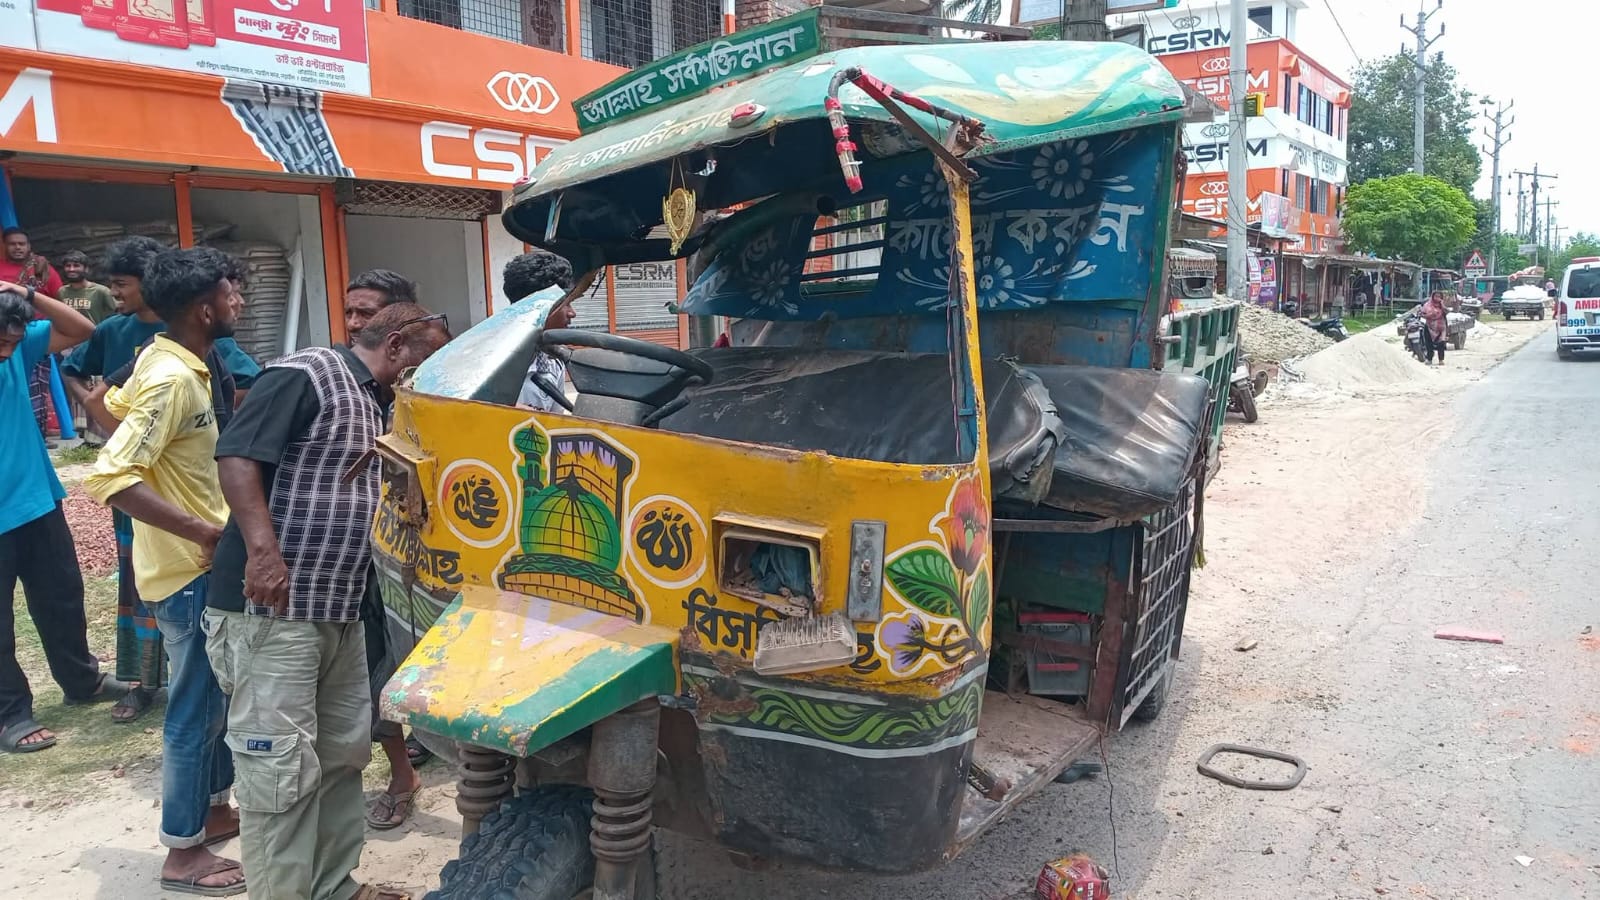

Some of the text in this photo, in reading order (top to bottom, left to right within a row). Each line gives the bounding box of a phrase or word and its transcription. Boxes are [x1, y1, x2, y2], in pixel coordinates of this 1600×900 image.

[275, 54, 289, 64] ভাই
[290, 56, 304, 67] ভাই
[580, 25, 805, 123] আল্লাহ সর্বশক্তিমান
[1005, 202, 1145, 256] করুন
[616, 264, 673, 280] CSRM
[1567, 319, 1586, 327] 999
